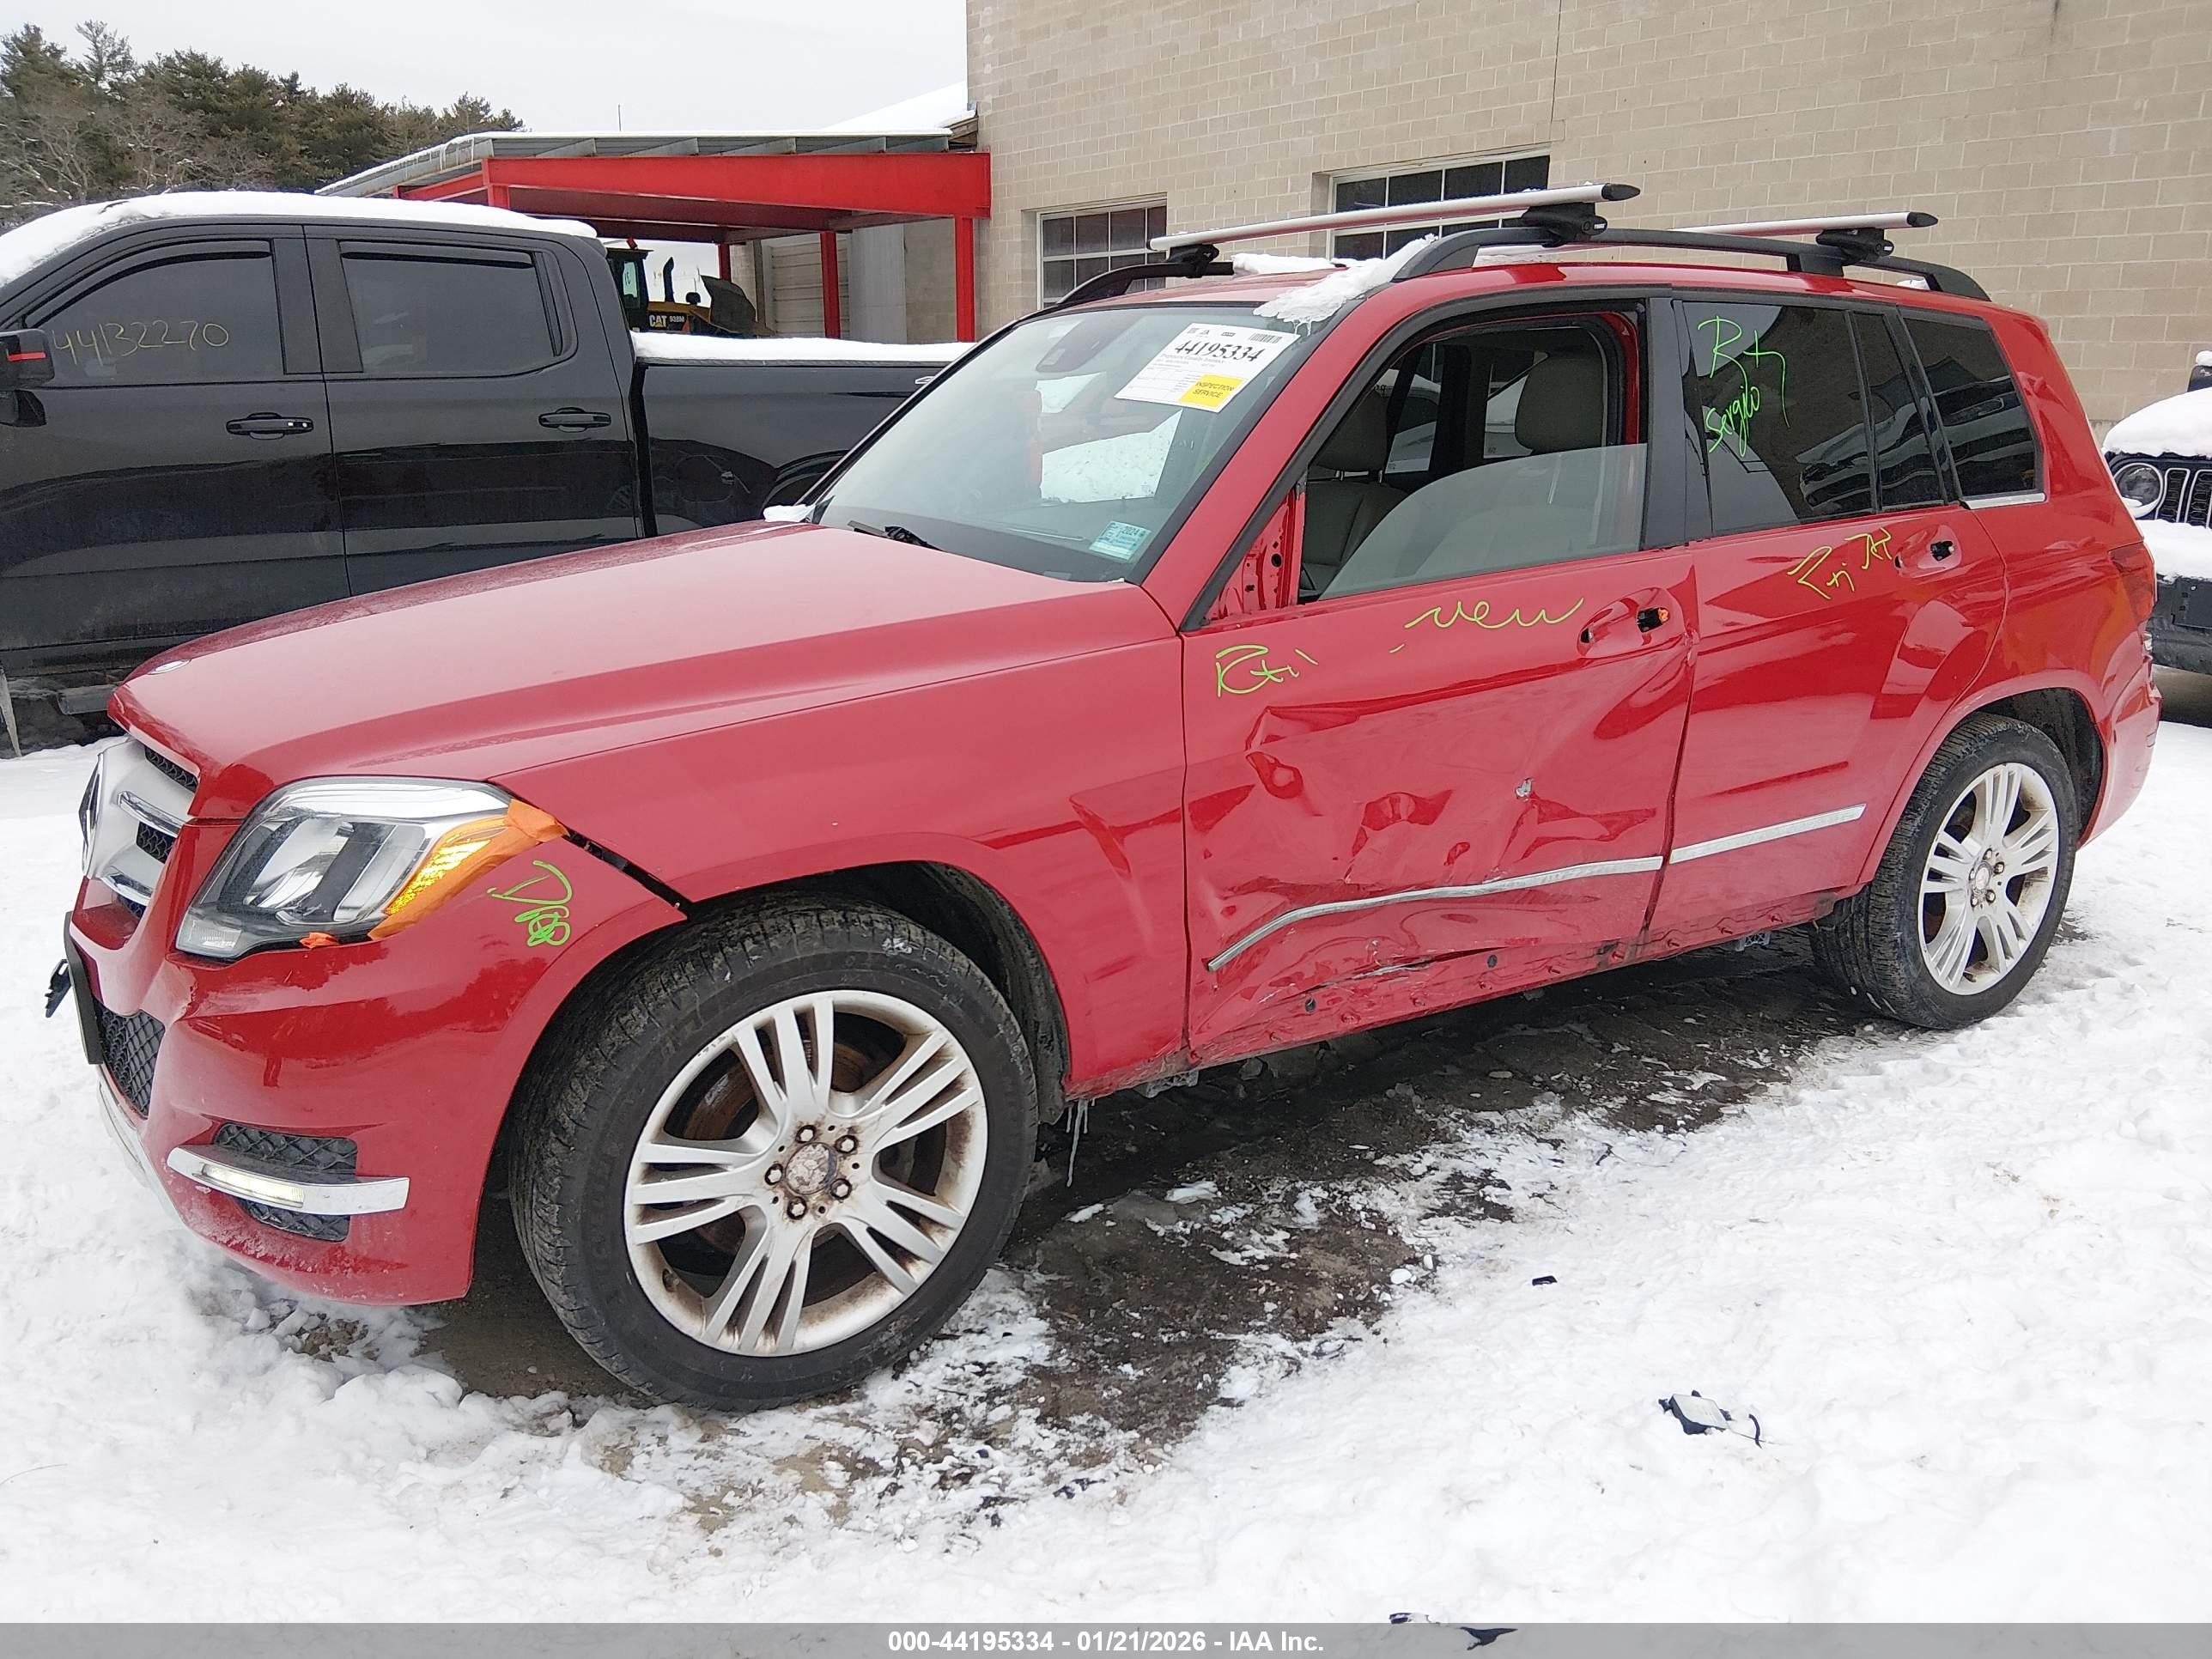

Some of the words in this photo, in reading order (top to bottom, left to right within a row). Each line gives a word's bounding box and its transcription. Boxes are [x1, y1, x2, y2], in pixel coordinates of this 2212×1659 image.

[649, 314, 667, 327] CAT
[52, 319, 229, 366] 44132270
[1175, 340, 1266, 362] 44195334
[1192, 388, 1224, 398] SERVICE
[1195, 381, 1235, 392] INSPECTION
